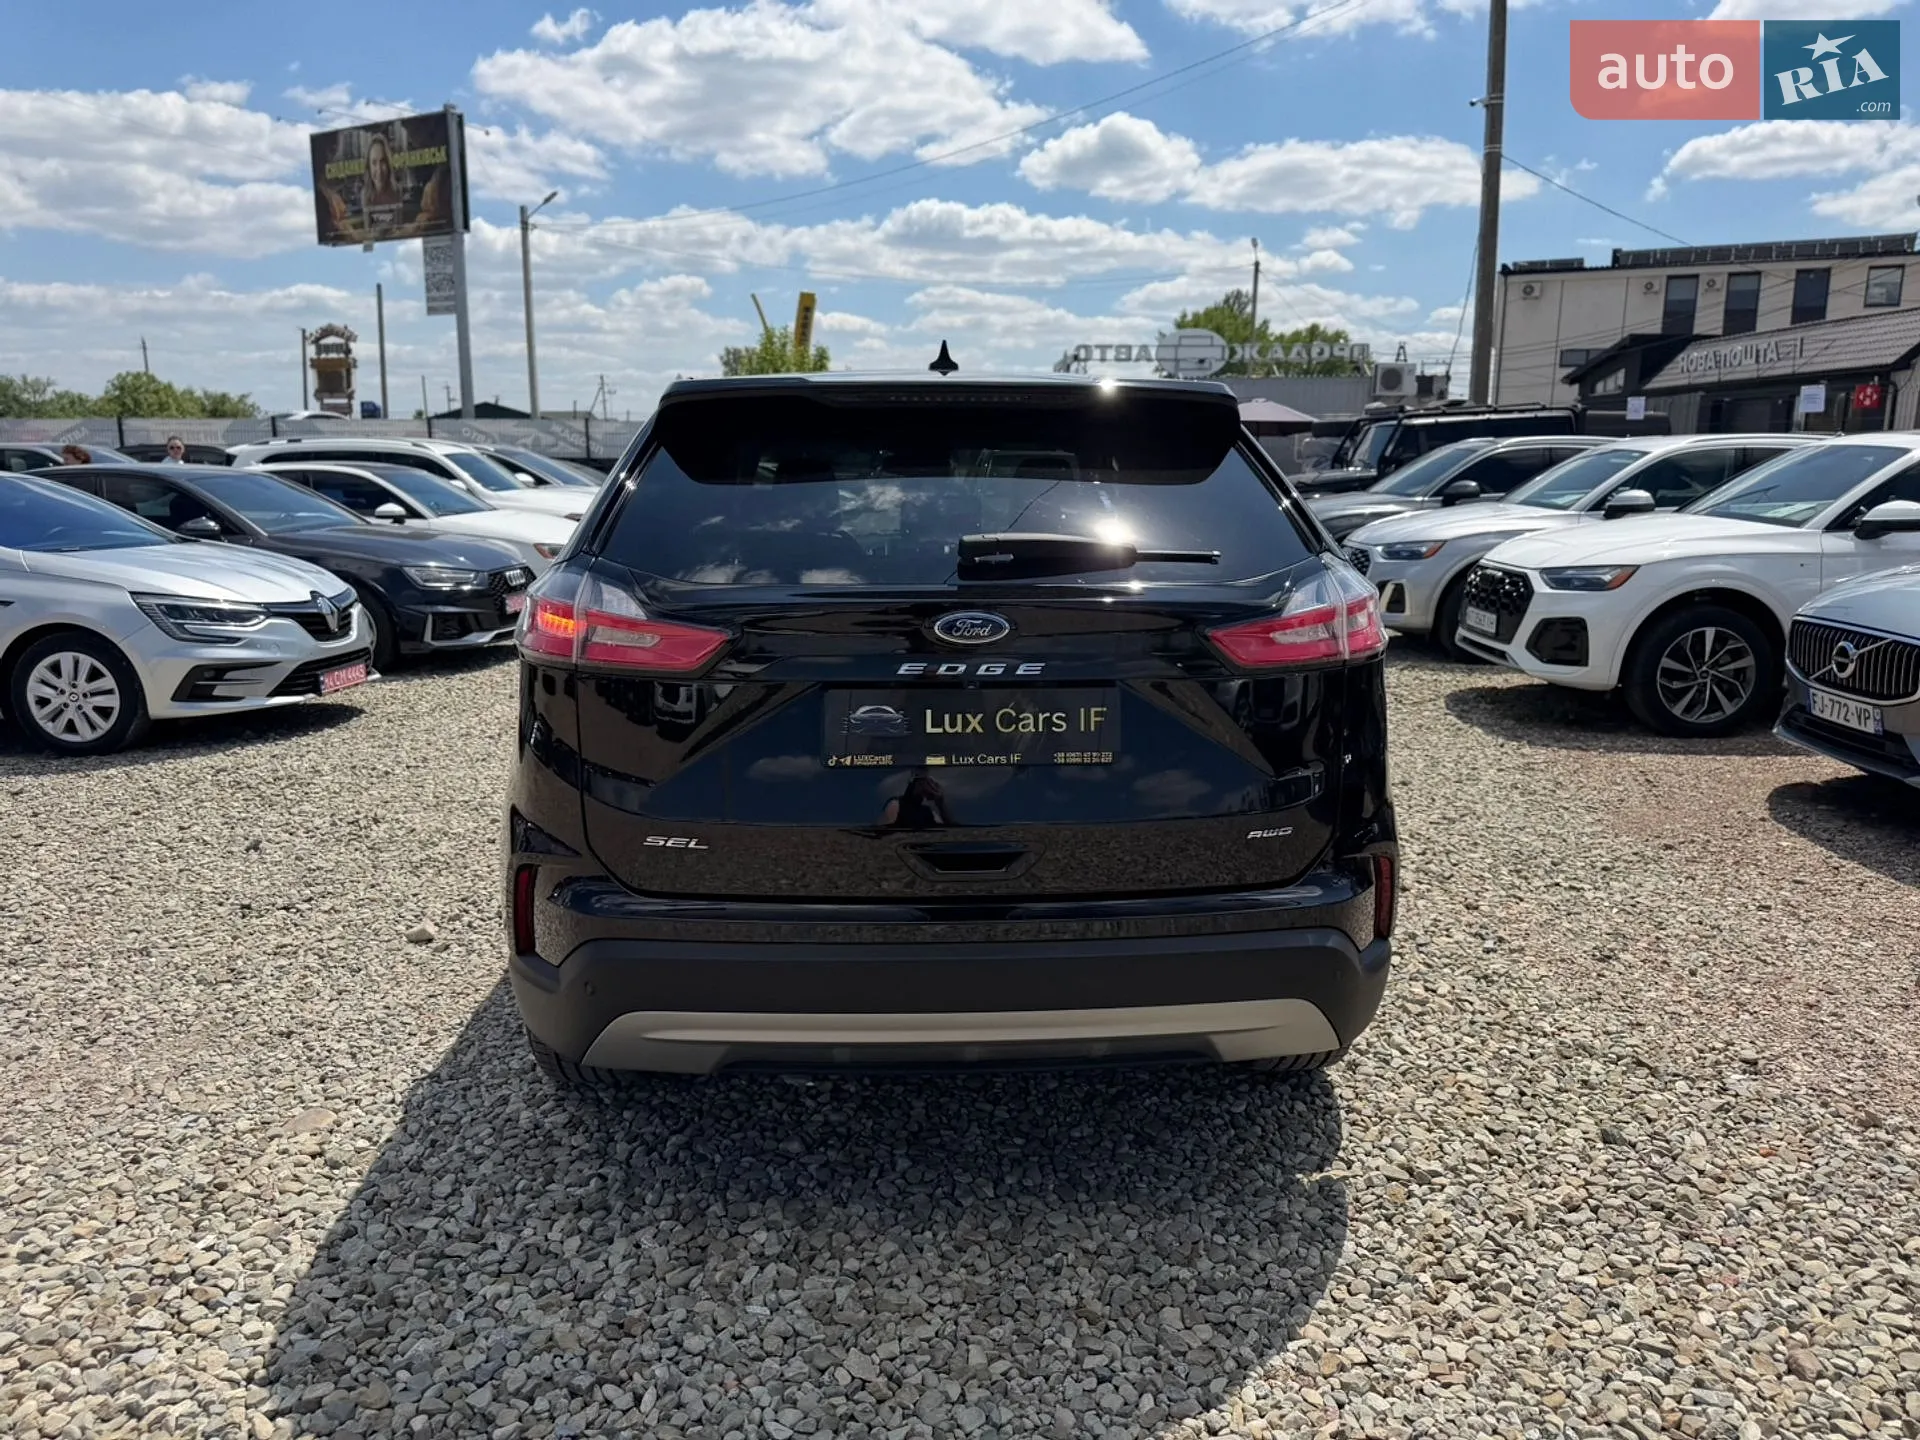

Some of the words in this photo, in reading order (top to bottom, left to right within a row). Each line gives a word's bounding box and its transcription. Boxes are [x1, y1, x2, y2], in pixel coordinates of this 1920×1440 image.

[1679, 350, 1717, 374] НОВА
[1720, 339, 1780, 368] ПОШТА
[952, 618, 992, 637] Ford
[896, 662, 1046, 675] EDGE
[925, 708, 984, 734] Lux
[995, 707, 1067, 732] Cars
[1080, 707, 1107, 732] IF
[952, 754, 974, 765] Lux
[977, 754, 1007, 764] Cars
[1009, 753, 1022, 764] IF
[1247, 826, 1294, 839] AWD
[643, 835, 709, 849] SEL
